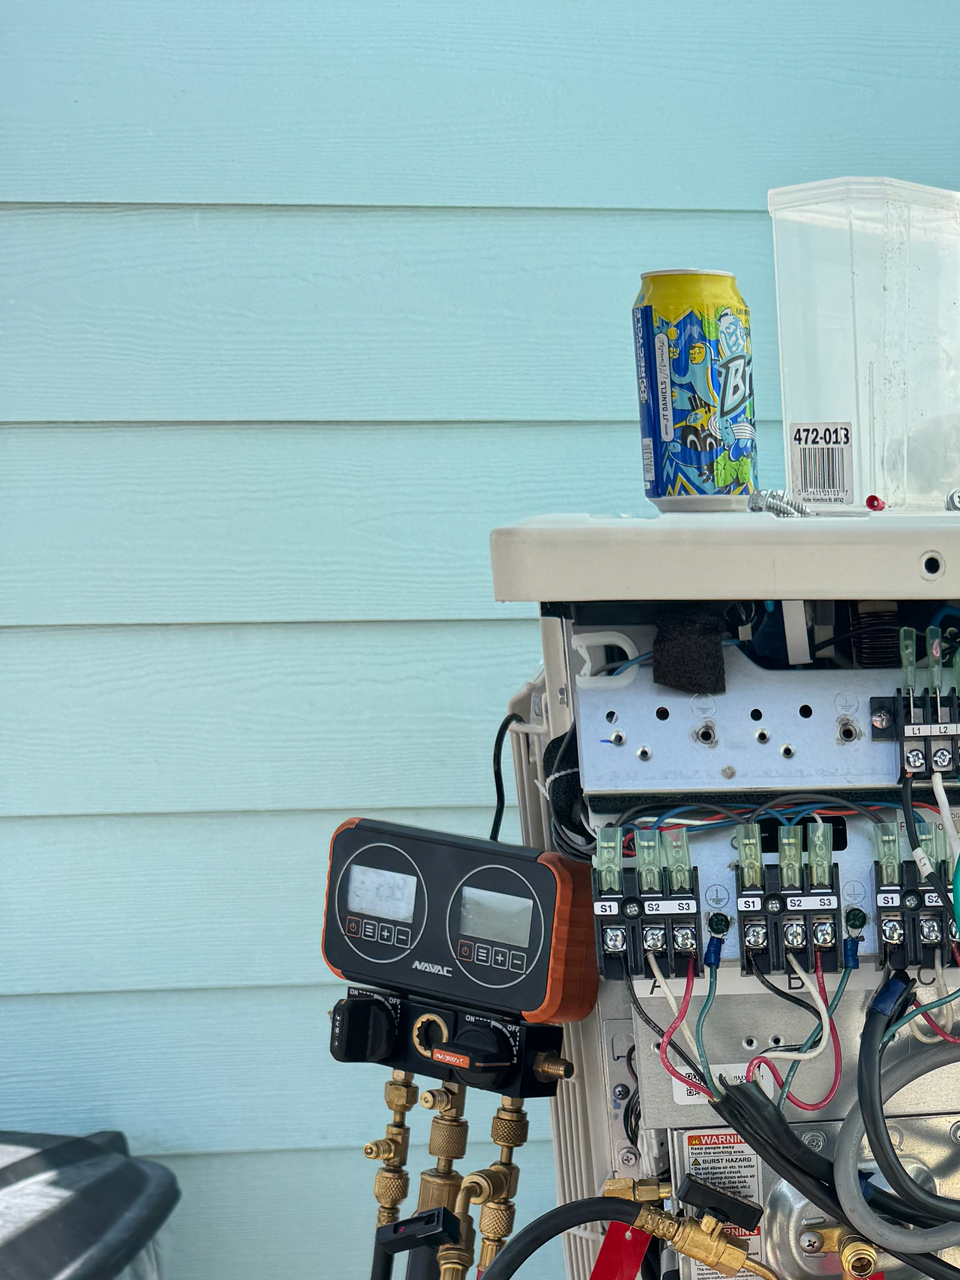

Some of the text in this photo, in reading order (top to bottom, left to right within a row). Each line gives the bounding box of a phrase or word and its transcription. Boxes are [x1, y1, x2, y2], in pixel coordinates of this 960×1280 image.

[660, 381, 668, 412] DANIELS
[663, 413, 669, 422] JT
[794, 427, 850, 446] 472-013
[912, 726, 921, 735] L1
[938, 725, 948, 734] L2
[918, 856, 926, 868] L1
[789, 899, 802, 908] S2
[819, 898, 832, 907] S3
[882, 895, 895, 905] S1
[927, 894, 940, 904] S2
[600, 904, 612, 913] S1
[647, 903, 660, 912] S2
[677, 902, 691, 911] S3
[743, 900, 756, 909] S1
[412, 960, 453, 977] NAVAC
[389, 997, 401, 1005] OFF
[465, 1015, 475, 1023] ON
[507, 1024, 520, 1033] OFF
[701, 1135, 744, 1144] WARNIN
